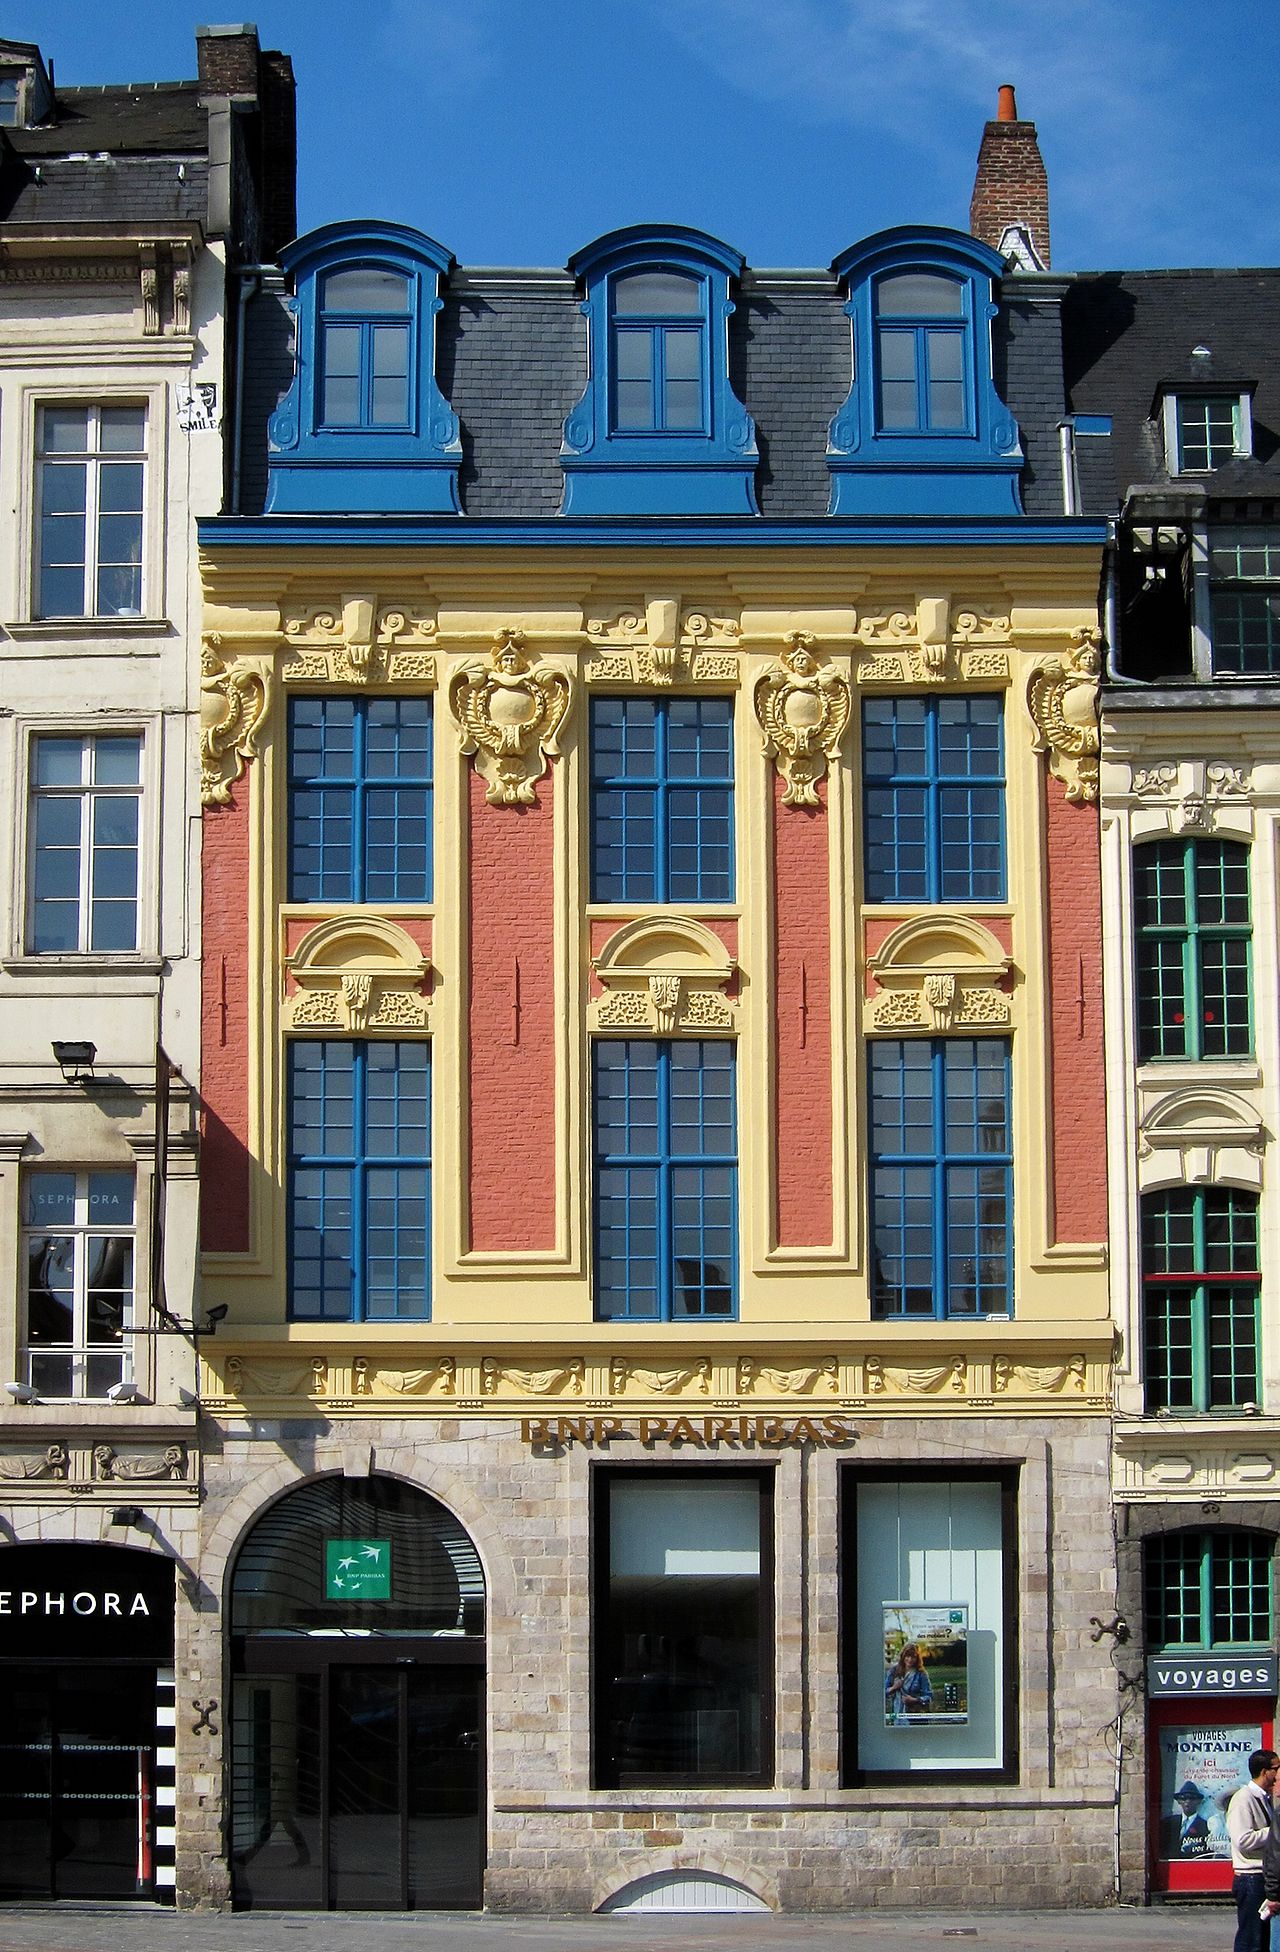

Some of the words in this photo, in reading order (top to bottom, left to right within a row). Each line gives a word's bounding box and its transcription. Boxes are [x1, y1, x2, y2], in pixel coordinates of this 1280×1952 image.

[38, 1194, 120, 1205] SEPHORA
[520, 1416, 623, 1443] BNP
[639, 1414, 849, 1442] PARIBAS
[1158, 1668, 1269, 1689] voyages
[1193, 1730, 1227, 1740] VOYAGES
[1167, 1741, 1253, 1752] MONTAINE
